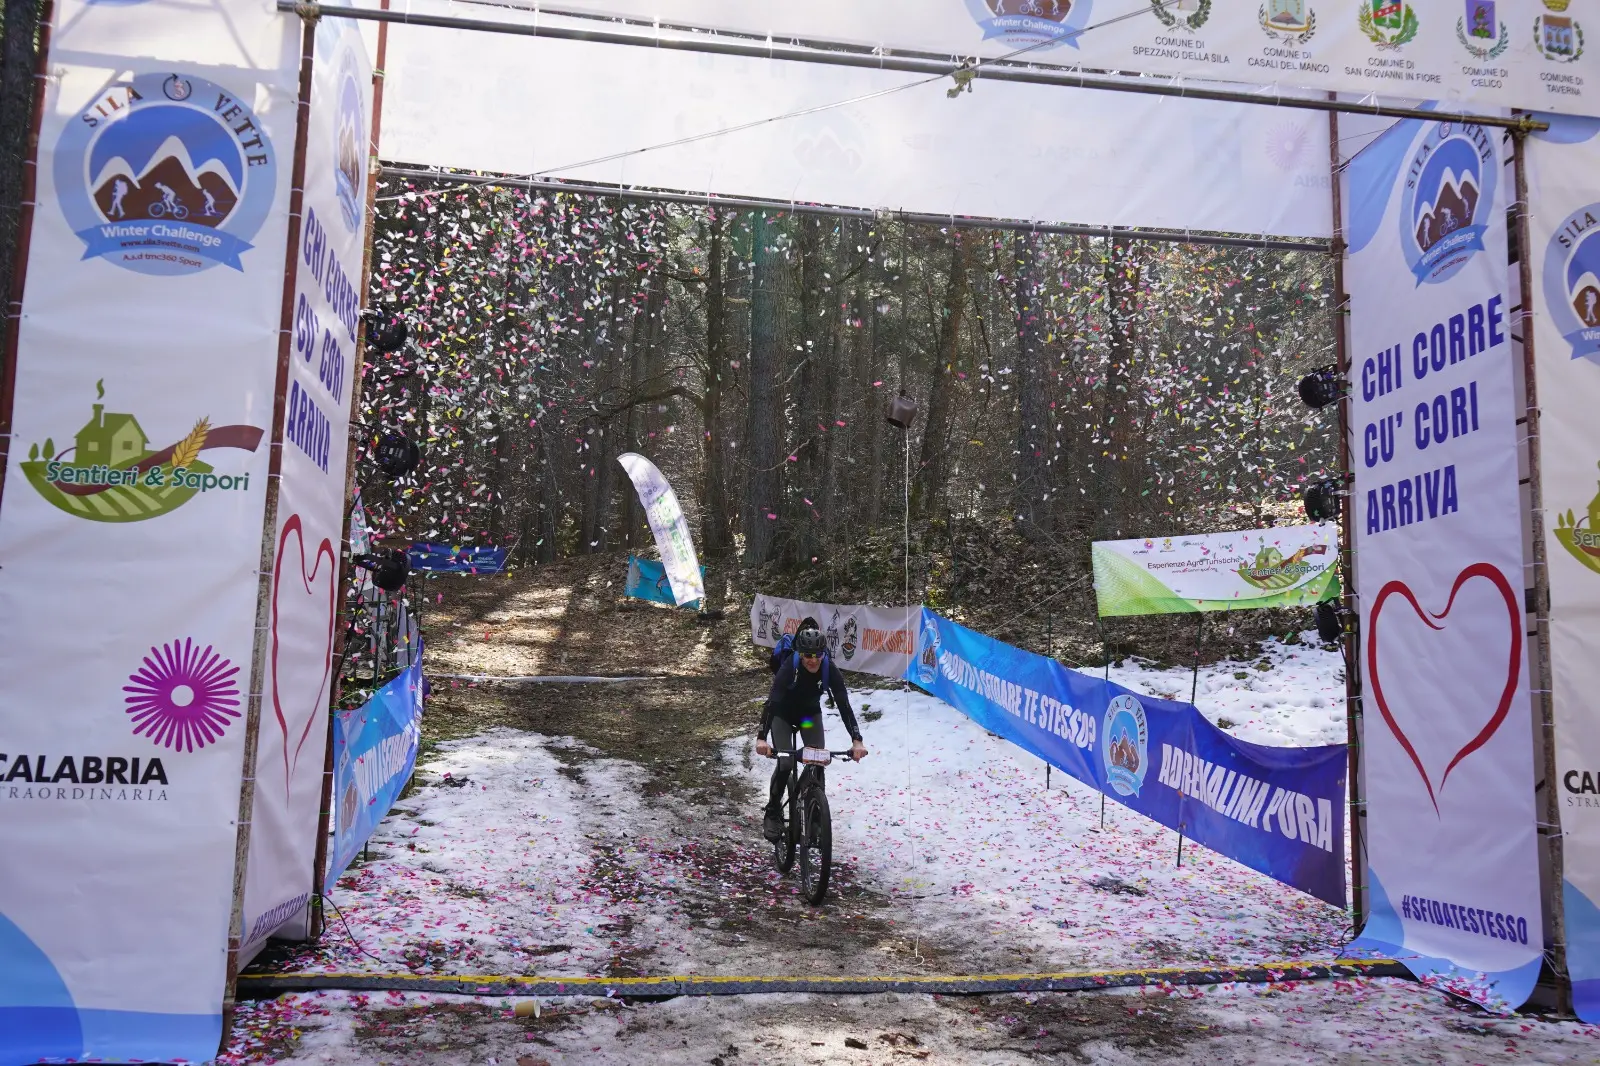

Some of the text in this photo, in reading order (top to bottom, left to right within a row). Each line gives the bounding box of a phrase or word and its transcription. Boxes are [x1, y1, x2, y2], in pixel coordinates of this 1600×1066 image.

[992, 18, 1020, 28] Winter
[1022, 18, 1065, 34] Challenge
[1155, 36, 1205, 49] COMUNE DI
[1263, 47, 1311, 59] COMUNE DI
[1133, 46, 1230, 64] SPEZZANO DELLA SILA
[1248, 58, 1330, 73] CASALI DEL MANCO
[1368, 57, 1415, 69] COMUNE DI
[1345, 67, 1441, 84] SAN GIOVANNI IN FIORE
[1462, 66, 1508, 78] COMUNE DI
[1471, 78, 1502, 89] CELICO
[1540, 72, 1584, 86] COMUNE DI
[1546, 84, 1581, 96] TAVERNA
[82, 86, 143, 127] SILA
[213, 93, 268, 167] VETTE
[1408, 144, 1431, 190] SILA
[101, 224, 222, 247] Winter Challenge
[1558, 211, 1598, 249] SILA
[145, 253, 177, 262] tmc360
[179, 256, 203, 268] Sport
[303, 206, 326, 287] CHI
[325, 248, 358, 343] CORRE
[296, 292, 345, 405] CU' CORI
[1362, 293, 1504, 402] CHI CORRE
[287, 379, 331, 475] ARRIVA
[1364, 381, 1479, 468] CU' CORI
[47, 462, 250, 492] Sentieri & Sapori
[1367, 465, 1458, 535] ARRIVA
[1147, 561, 1186, 571] Esperienze
[1186, 559, 1204, 568] Agro
[1206, 556, 1240, 566] Turistiche
[1284, 566, 1294, 574] &
[1295, 563, 1325, 574] Sapori
[1024, 688, 1039, 725] TE
[1038, 694, 1097, 752] STESSO?
[0, 753, 169, 785] ALABRIA
[0, 786, 168, 801] RAORDINARIA
[1563, 769, 1600, 795] CA
[1158, 743, 1333, 853] ADRENALINA PURA
[1402, 894, 1528, 945] #SFIDATESTESSO
